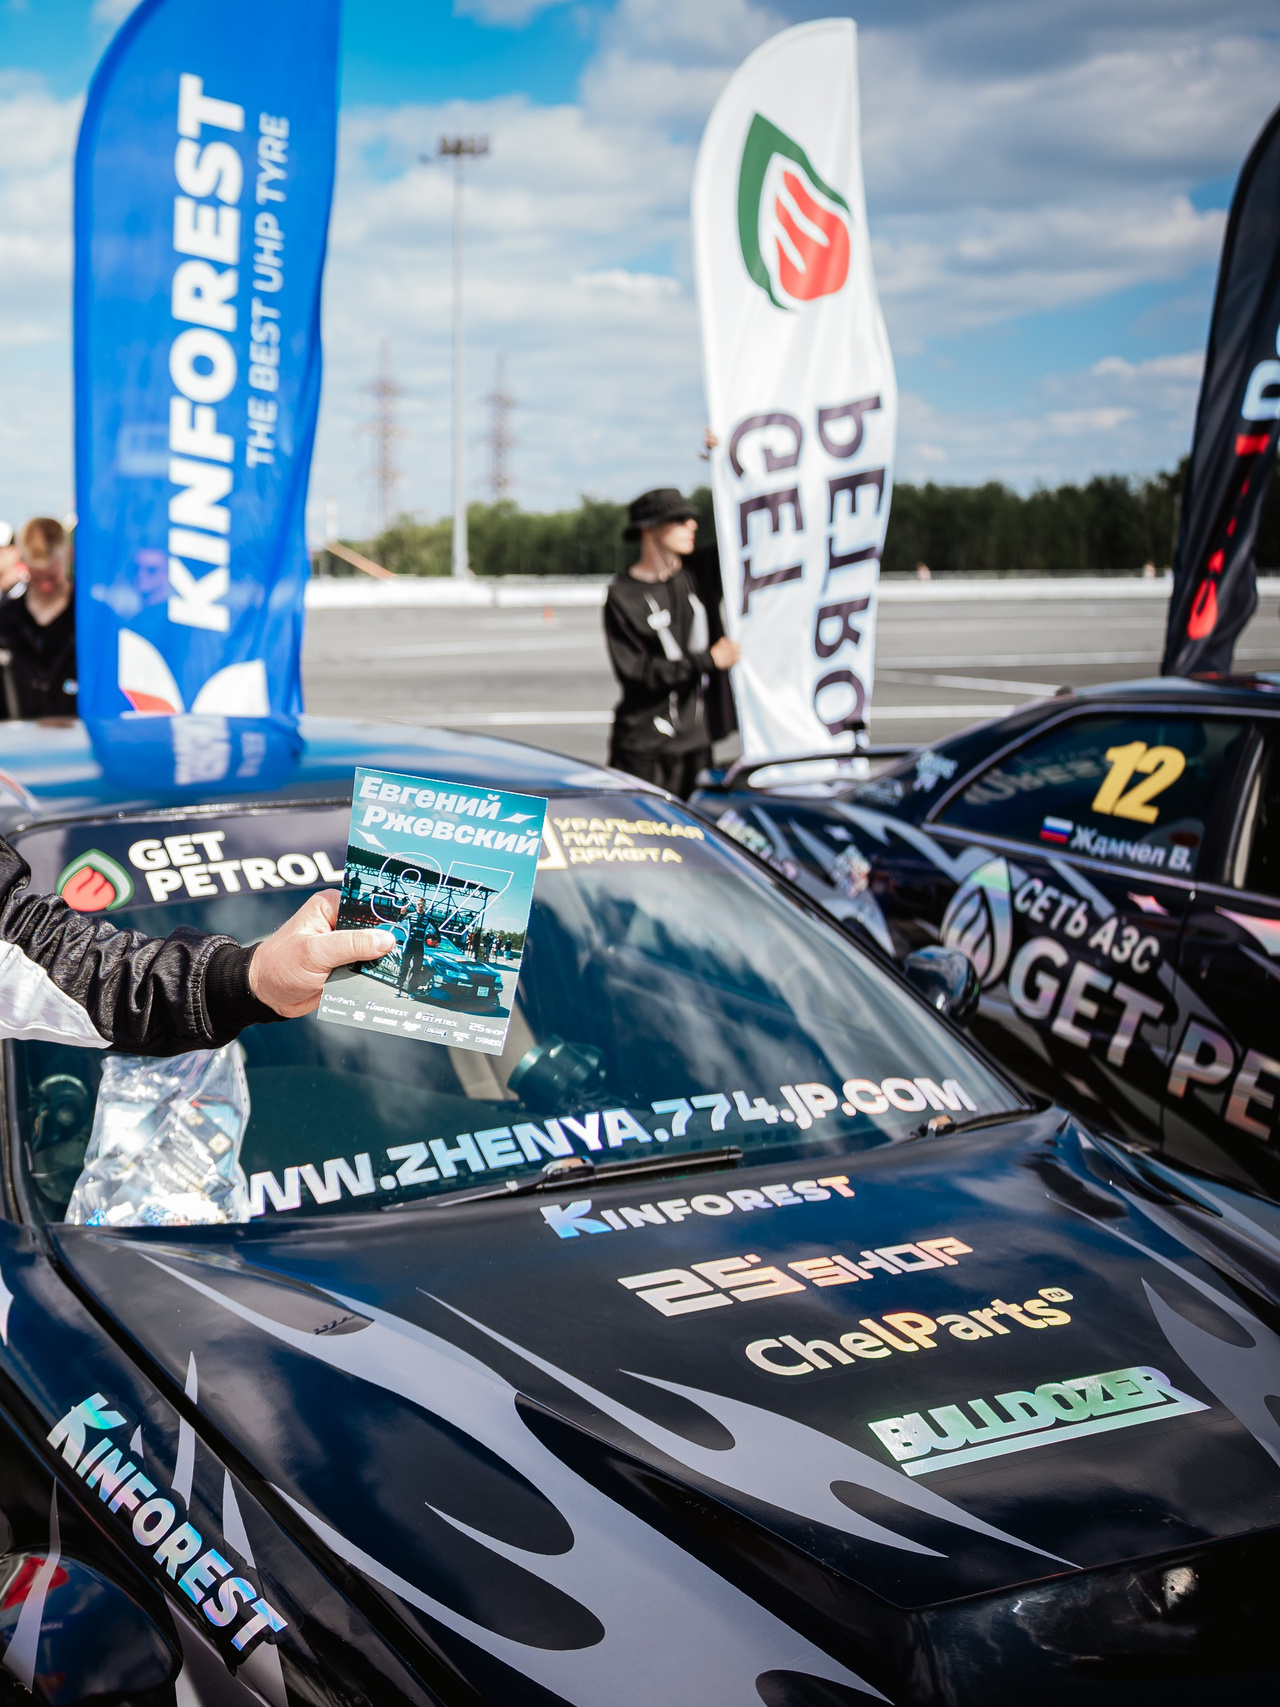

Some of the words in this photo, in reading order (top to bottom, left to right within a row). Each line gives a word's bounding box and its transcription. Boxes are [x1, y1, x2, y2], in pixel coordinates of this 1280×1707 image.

[256, 112, 292, 207] TYRE
[251, 211, 287, 294] UHP
[167, 72, 246, 633] KINFOREST
[247, 298, 285, 394] BEST
[245, 396, 278, 470] THE
[358, 775, 503, 821] Евгений
[1092, 740, 1187, 825] 12
[128, 830, 226, 871] GET
[361, 804, 542, 857] Ржевский
[145, 851, 345, 903] PETROL
[370, 851, 515, 936] 97
[1088, 916, 1160, 974] АЗС
[1008, 936, 1165, 1068] GET
[540, 1174, 857, 1240] KINFOREST
[786, 1236, 974, 1288] SHOP
[745, 1298, 1073, 1377] ChelParts
[869, 1366, 1211, 1462] BULLDOZER
[46, 1392, 289, 1652] KINFOREST
